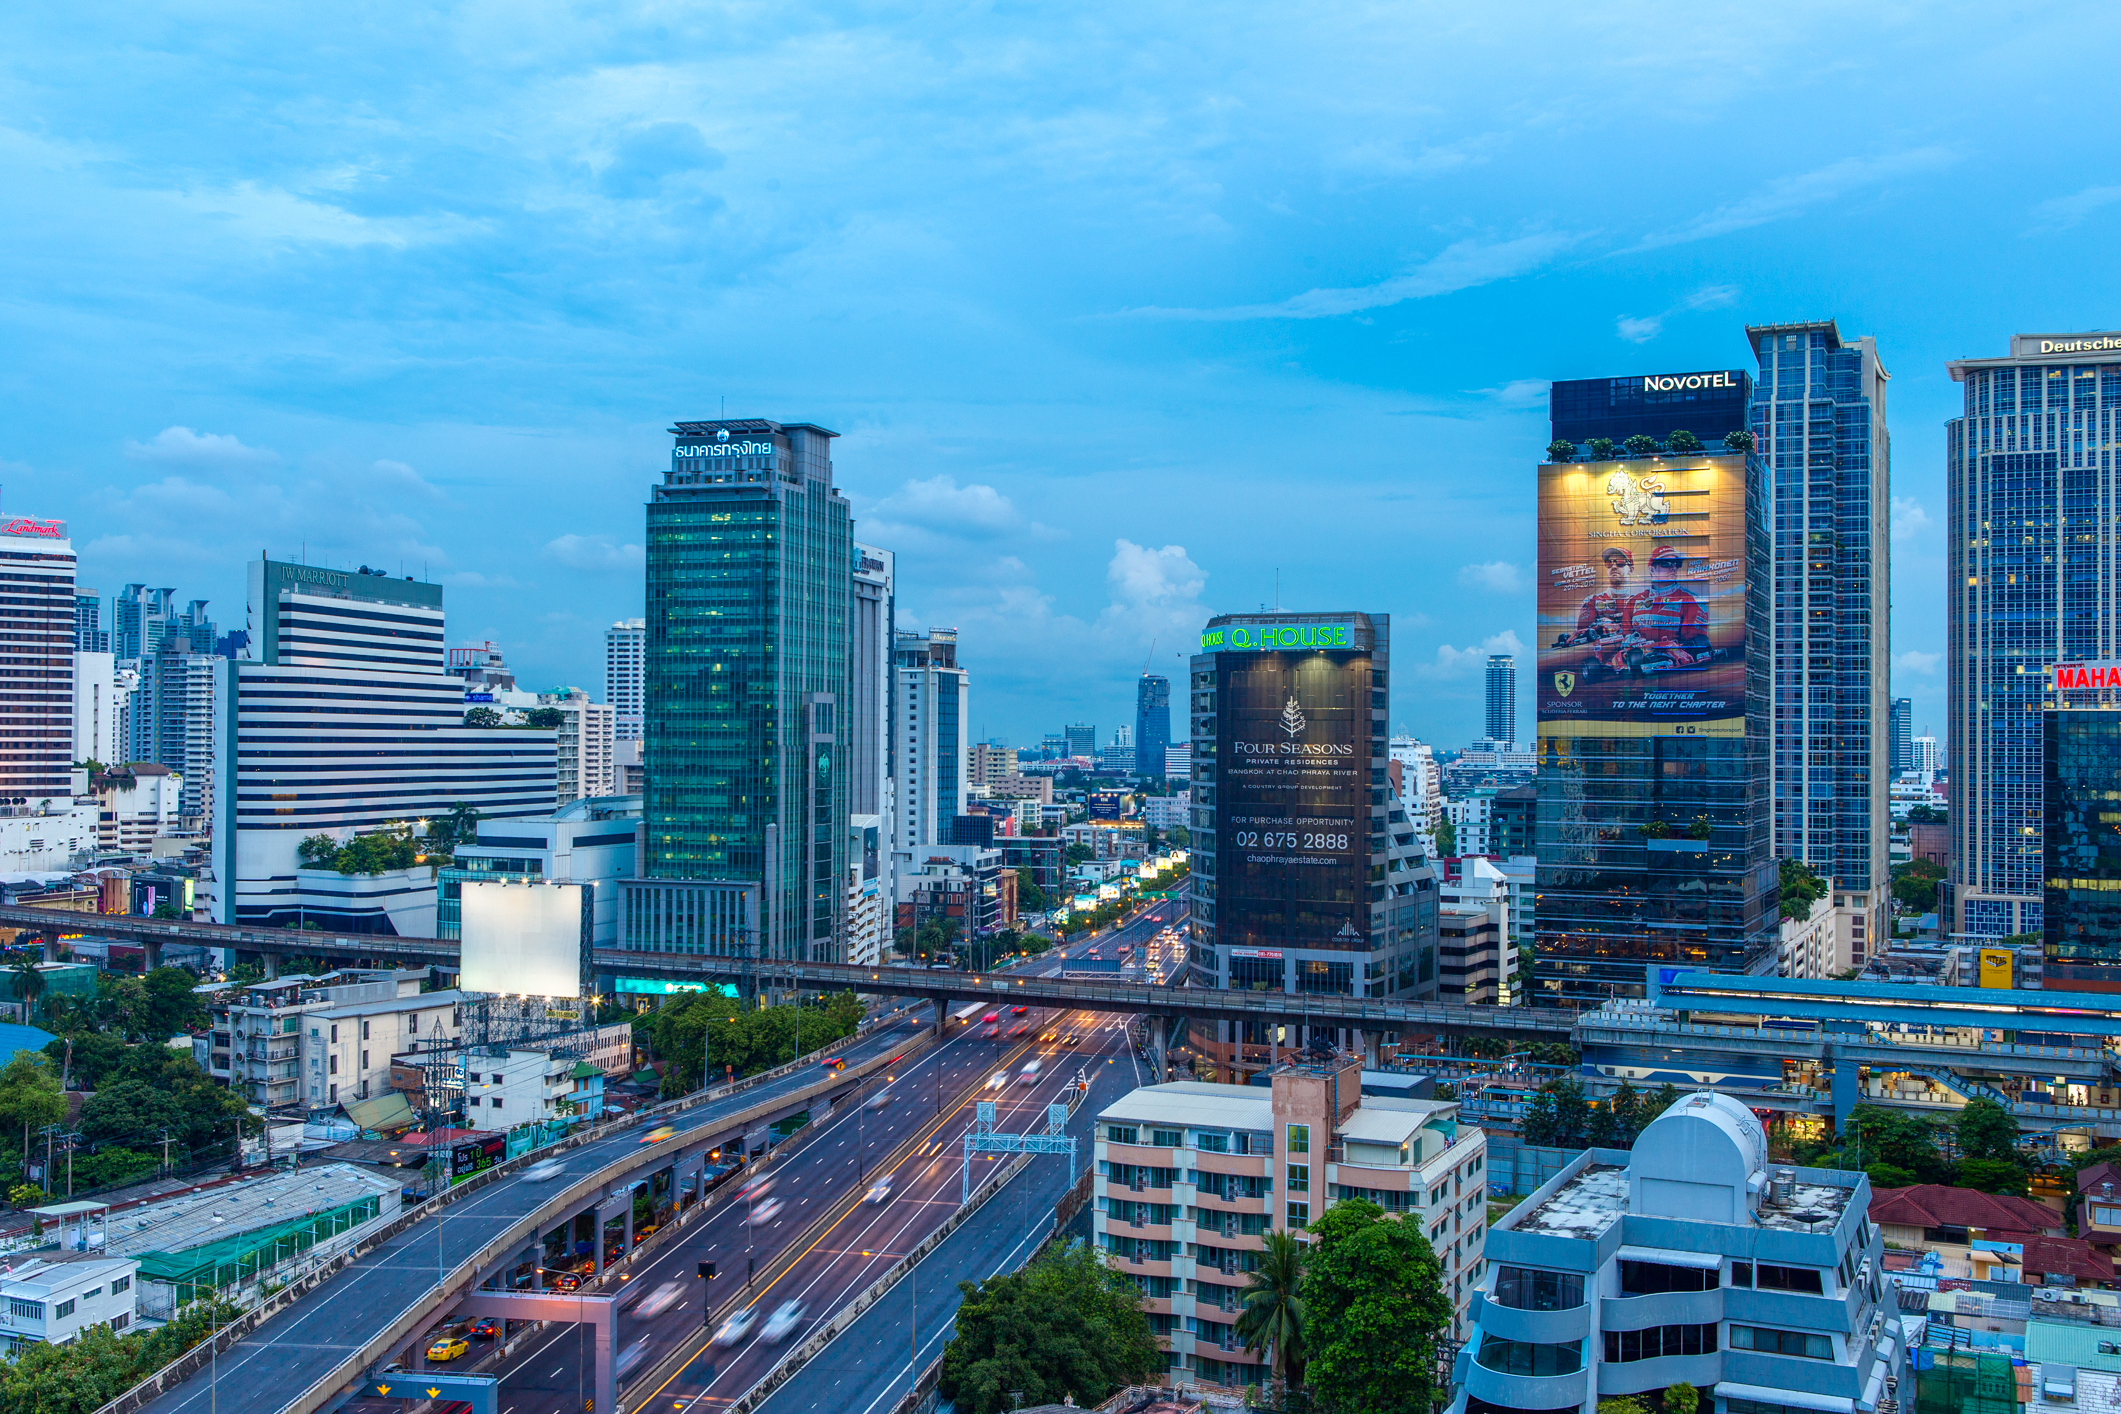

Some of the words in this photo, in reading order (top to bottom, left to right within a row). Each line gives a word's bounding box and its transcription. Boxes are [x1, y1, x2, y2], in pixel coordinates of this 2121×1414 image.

[2040, 336, 2121, 354] Deutsche
[1644, 371, 1737, 392] NOVOTEL
[675, 440, 772, 459] ธนาคารกรุงไทย
[1, 519, 61, 537] Landmark
[1588, 530, 1622, 539] SINGHA
[1624, 527, 1689, 537] CORPORATION
[281, 566, 295, 582] JW
[296, 568, 349, 588] MARRIOTT
[1563, 566, 1597, 579] VETTEL
[2057, 666, 2121, 689] MAHA
[1643, 692, 1695, 700] TOGETHER
[1233, 742, 1275, 754] FOUR
[1280, 742, 1353, 755] SEASONS
[1231, 816, 1247, 824] FOR
[1249, 816, 1293, 825] PURCHASE
[1296, 817, 1355, 826] OPPORTUNITY
[1236, 831, 1258, 847] 02
[1263, 832, 1297, 848] 675
[1303, 833, 1348, 849] 2888
[1246, 854, 1337, 865] chaophrayaestate.com
[476, 1156, 492, 1170] 365
